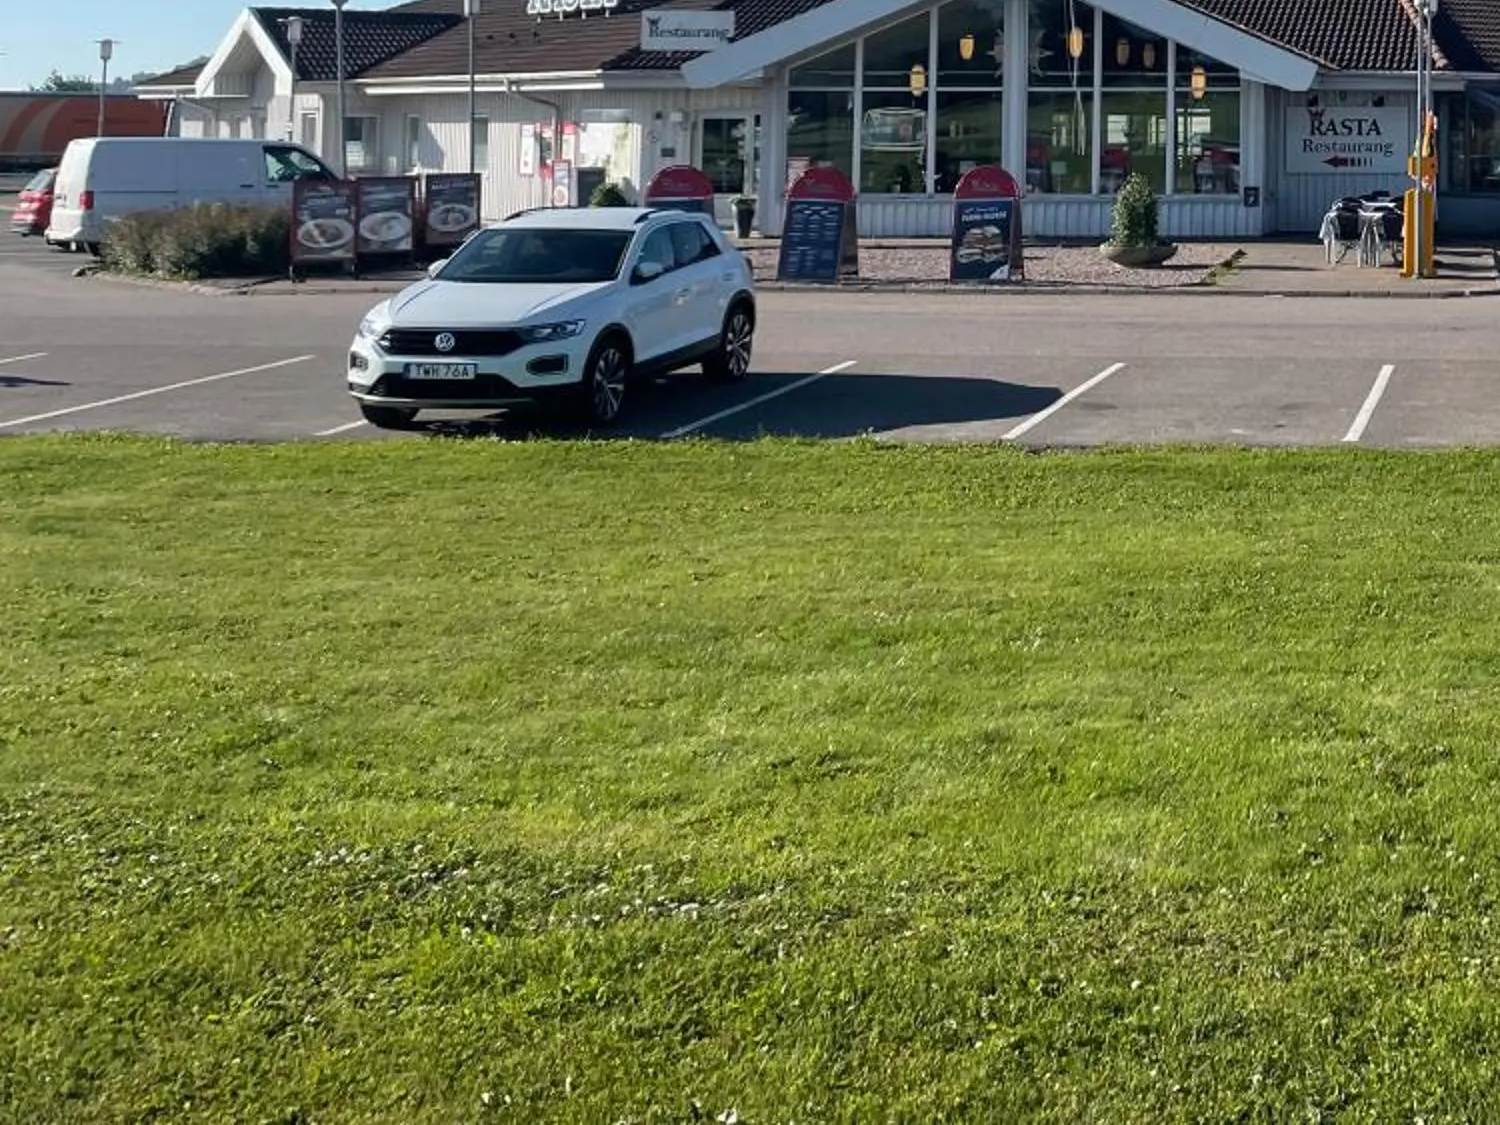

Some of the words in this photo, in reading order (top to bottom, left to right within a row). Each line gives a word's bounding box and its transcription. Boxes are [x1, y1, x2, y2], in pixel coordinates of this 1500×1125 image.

[649, 24, 730, 41] Restaurang
[1310, 118, 1382, 136] RASTA
[1302, 138, 1395, 157] Restaurang
